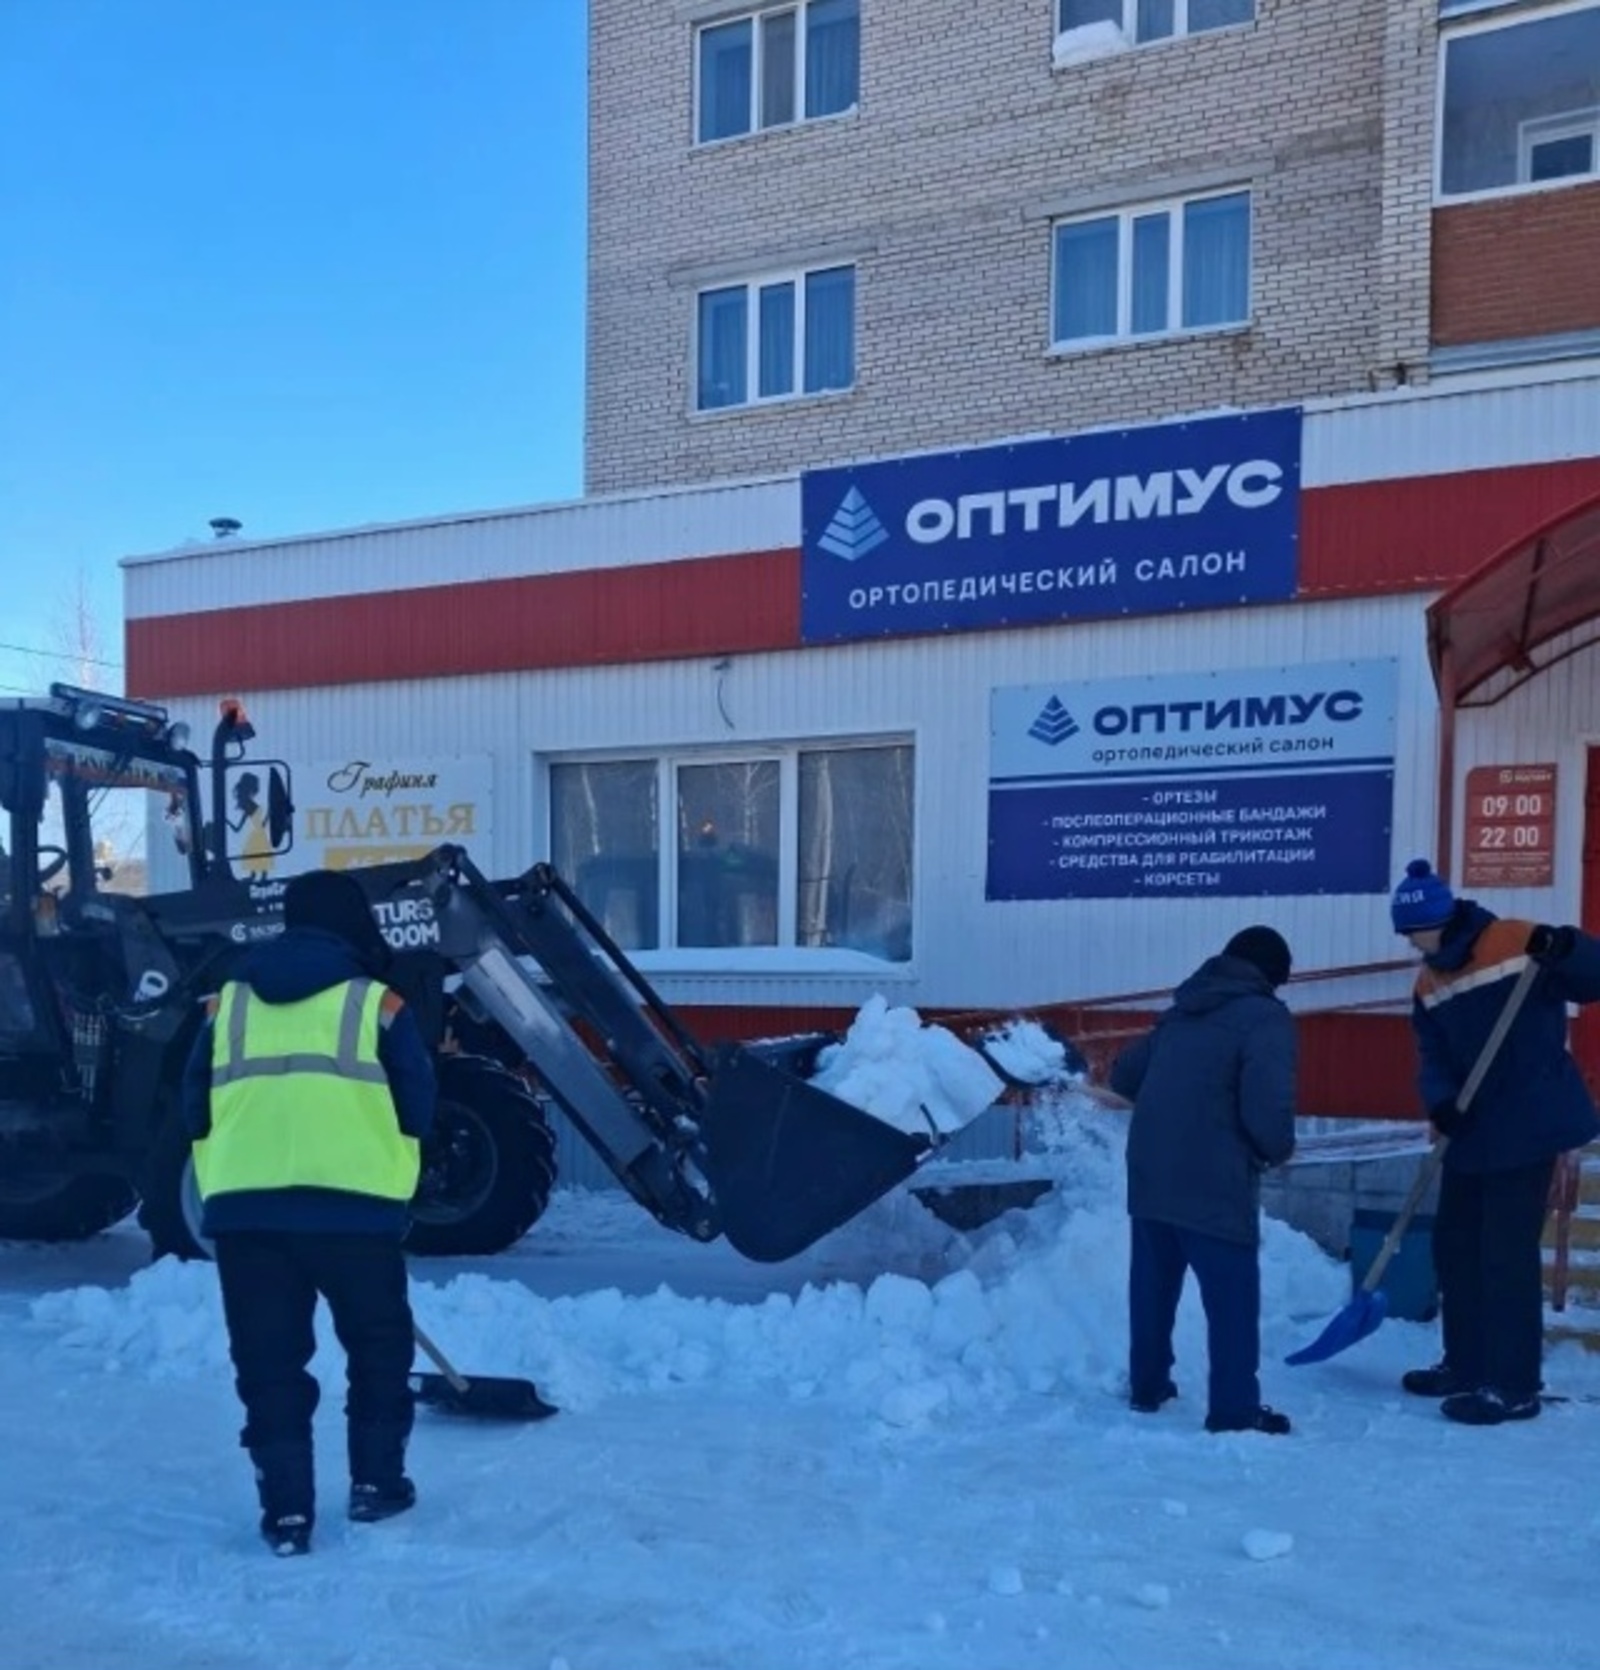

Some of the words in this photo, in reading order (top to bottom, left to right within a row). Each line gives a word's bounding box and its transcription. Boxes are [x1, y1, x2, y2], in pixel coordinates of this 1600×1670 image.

[905, 459, 1283, 544] ОПТИМУС
[849, 559, 1117, 609] ОРТОПЕДИЧЕСКИЙ
[1135, 551, 1246, 582] САЛОН
[1093, 690, 1364, 736] ОПТИМУС
[1092, 737, 1264, 766] ортопедический
[1269, 736, 1333, 759] салон
[327, 761, 438, 798] Графиня
[1153, 790, 1218, 805] ОРТЕЗЫ
[1482, 795, 1508, 817] 09
[1515, 794, 1541, 816] 00
[304, 803, 477, 840] ПЛАТЬЯ
[1052, 809, 1235, 829] ПОСЛЕОПЕРАЦИОННЫЕ
[1239, 806, 1327, 824] БАНДАЖИ
[1062, 828, 1216, 848] КОМПРЕССИОННЫЙ
[1220, 827, 1314, 844] ТРИКОТАЖ
[1479, 826, 1507, 848] 22
[1513, 825, 1539, 847] 00
[1059, 853, 1139, 869] СРЕДСТВА
[1141, 852, 1176, 867] ДЛЯ
[1179, 848, 1316, 866] РЕАБИЛИТАЦИИ
[1144, 872, 1220, 886] КОРСЕТЫ
[373, 898, 434, 926] TURS
